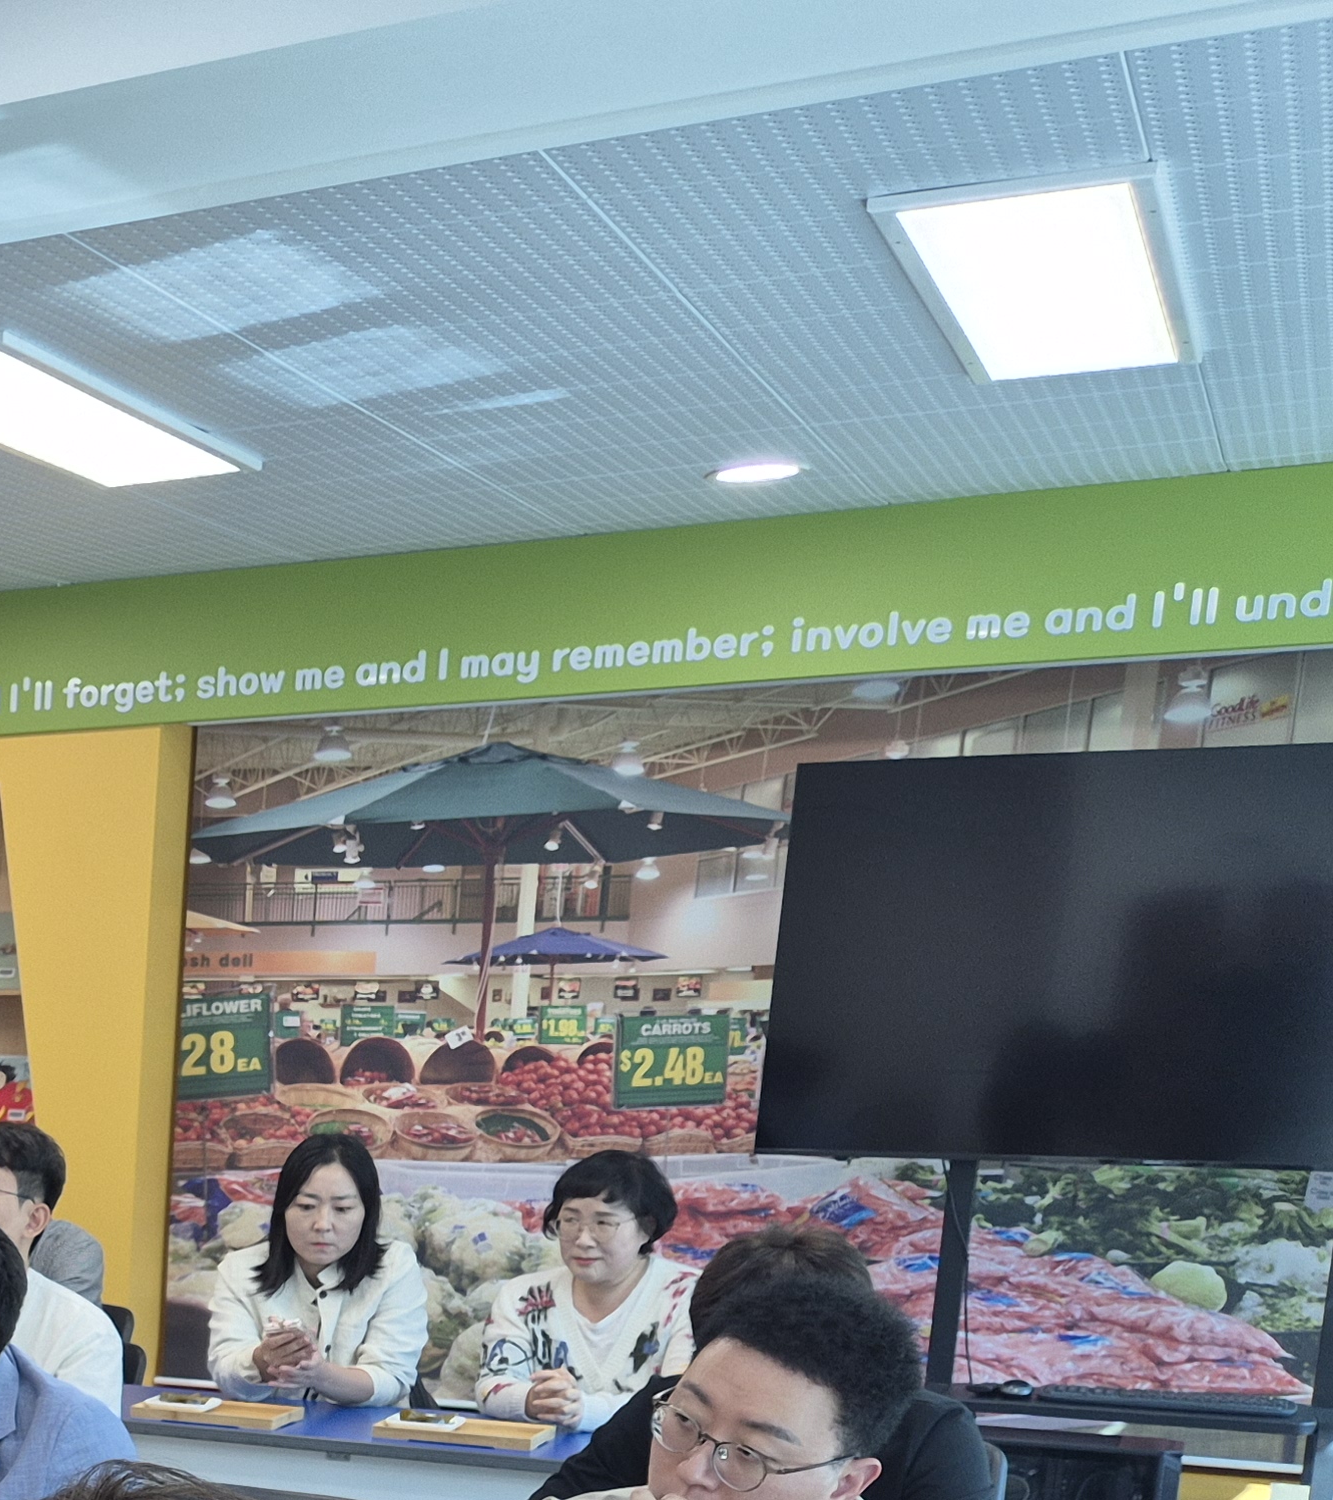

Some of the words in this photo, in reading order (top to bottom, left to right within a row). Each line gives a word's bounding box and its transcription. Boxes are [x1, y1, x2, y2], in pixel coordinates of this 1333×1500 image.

[9, 677, 54, 714] I'll
[63, 671, 186, 713] forget;
[196, 666, 286, 700] show
[294, 665, 346, 692] me
[355, 649, 427, 687] and
[437, 648, 449, 681] I
[459, 650, 541, 684] may
[551, 625, 775, 673] remember;
[790, 611, 953, 655] involve
[966, 611, 1030, 642] me
[1044, 593, 1137, 637] and
[1150, 582, 1220, 630] I'll
[1234, 578, 1333, 624] und
[641, 1021, 711, 1037] CARROTS
[237, 1057, 262, 1072] EA
[619, 1046, 705, 1087] $2.48
[704, 1072, 724, 1084] EA
